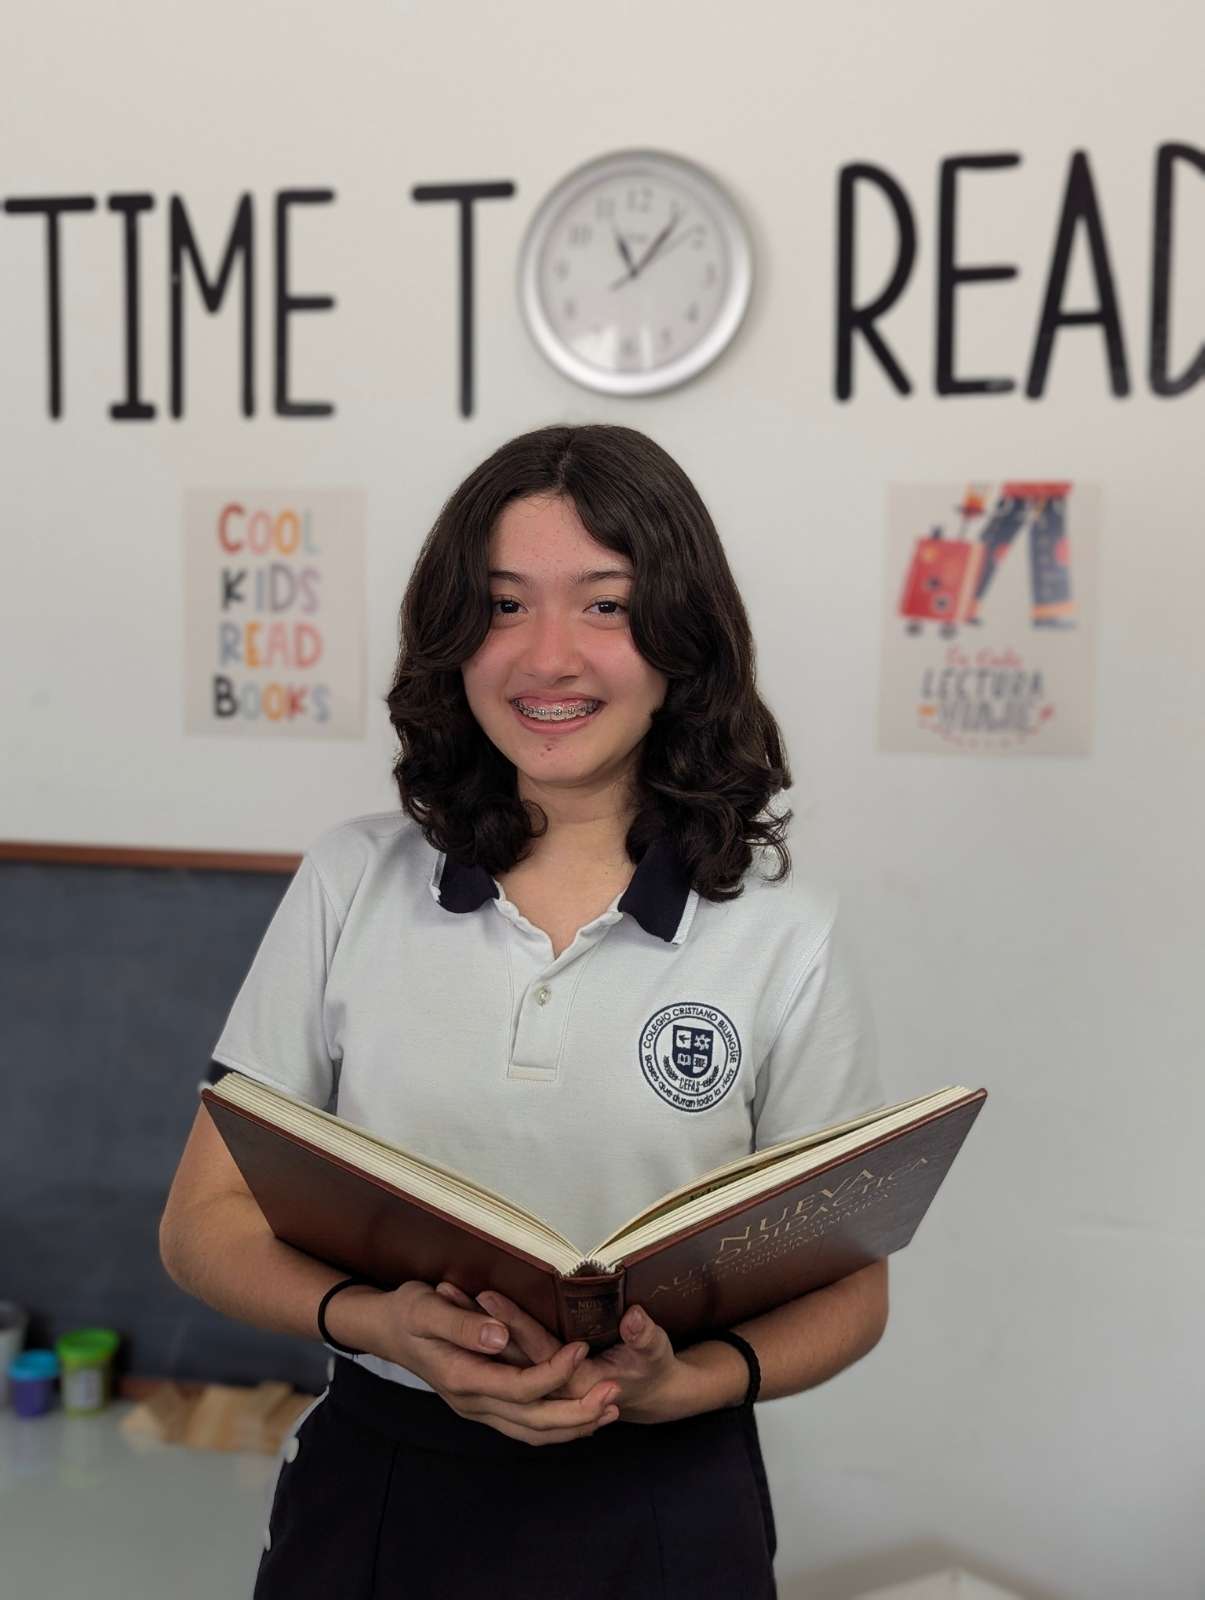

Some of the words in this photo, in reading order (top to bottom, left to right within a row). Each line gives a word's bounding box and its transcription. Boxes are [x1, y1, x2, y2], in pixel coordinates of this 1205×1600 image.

[3, 189, 335, 420] TIME
[217, 502, 320, 556] COOL
[221, 562, 321, 615] KIDS
[218, 621, 324, 669] READ
[212, 673, 331, 723] BOOKS
[643, 1012, 671, 1049] COLEGIO
[673, 1007, 718, 1022] CRISTIANO
[720, 1168, 874, 1251] NUEVA
